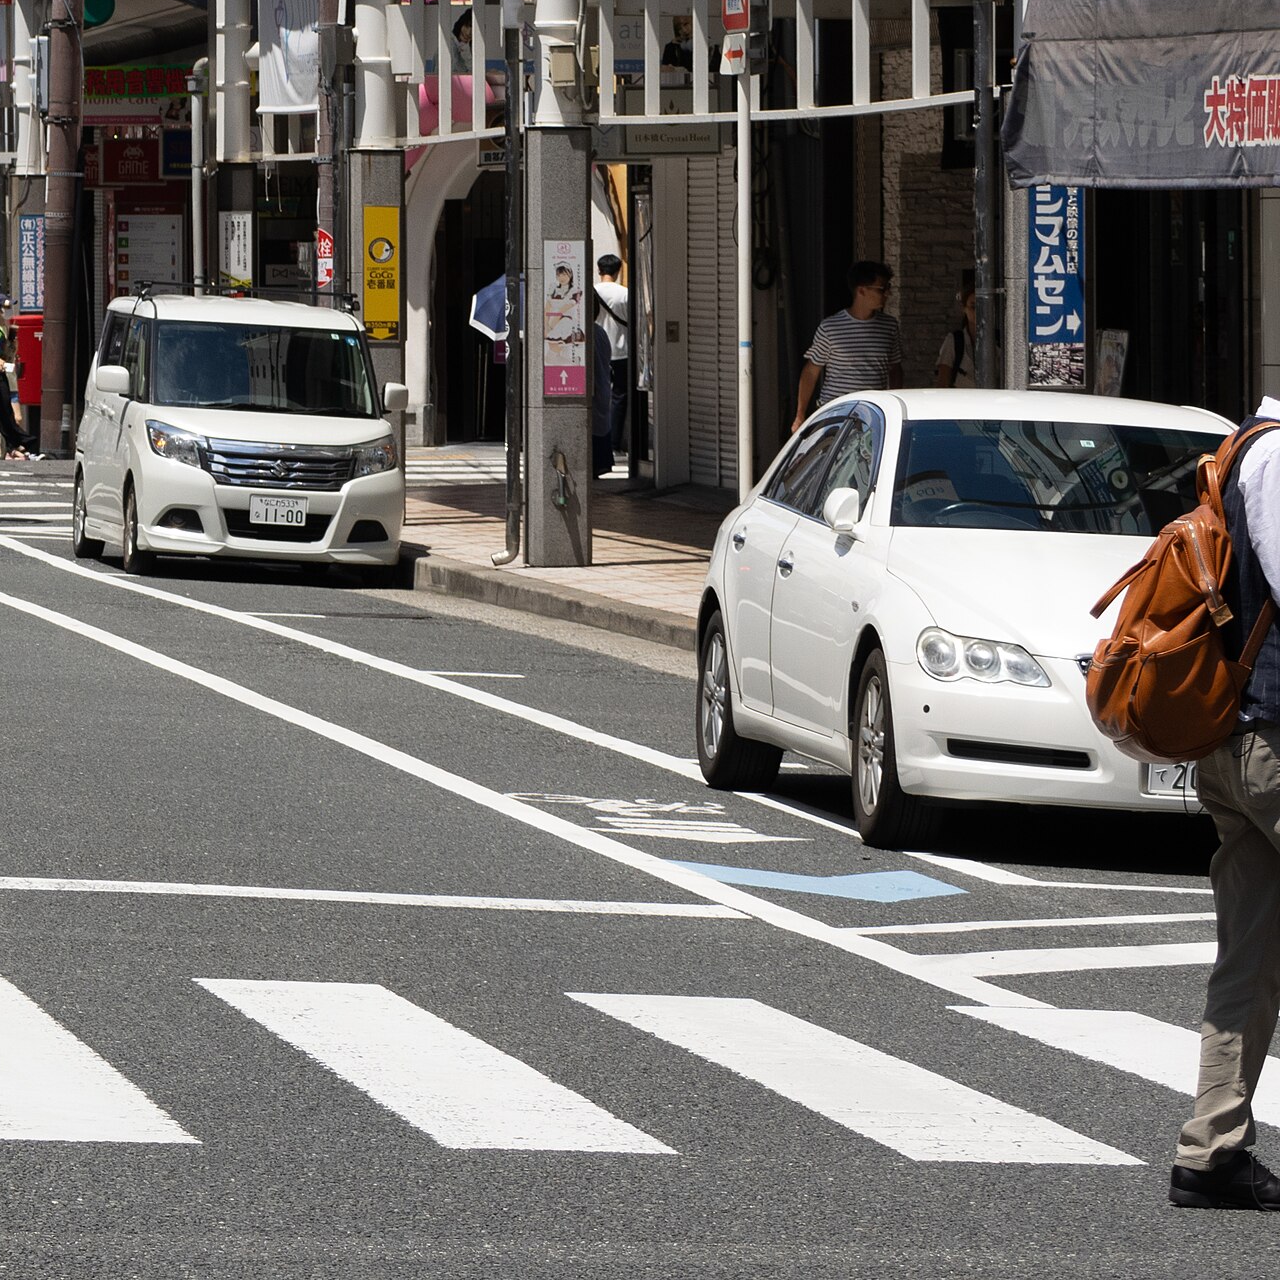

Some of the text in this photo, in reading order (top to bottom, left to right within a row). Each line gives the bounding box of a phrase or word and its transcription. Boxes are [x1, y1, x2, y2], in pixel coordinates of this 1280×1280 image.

[118, 160, 149, 175] GAME
[368, 271, 394, 279] CoCo
[366, 279, 396, 290] 壱番屋
[264, 507, 304, 524] 11-00
